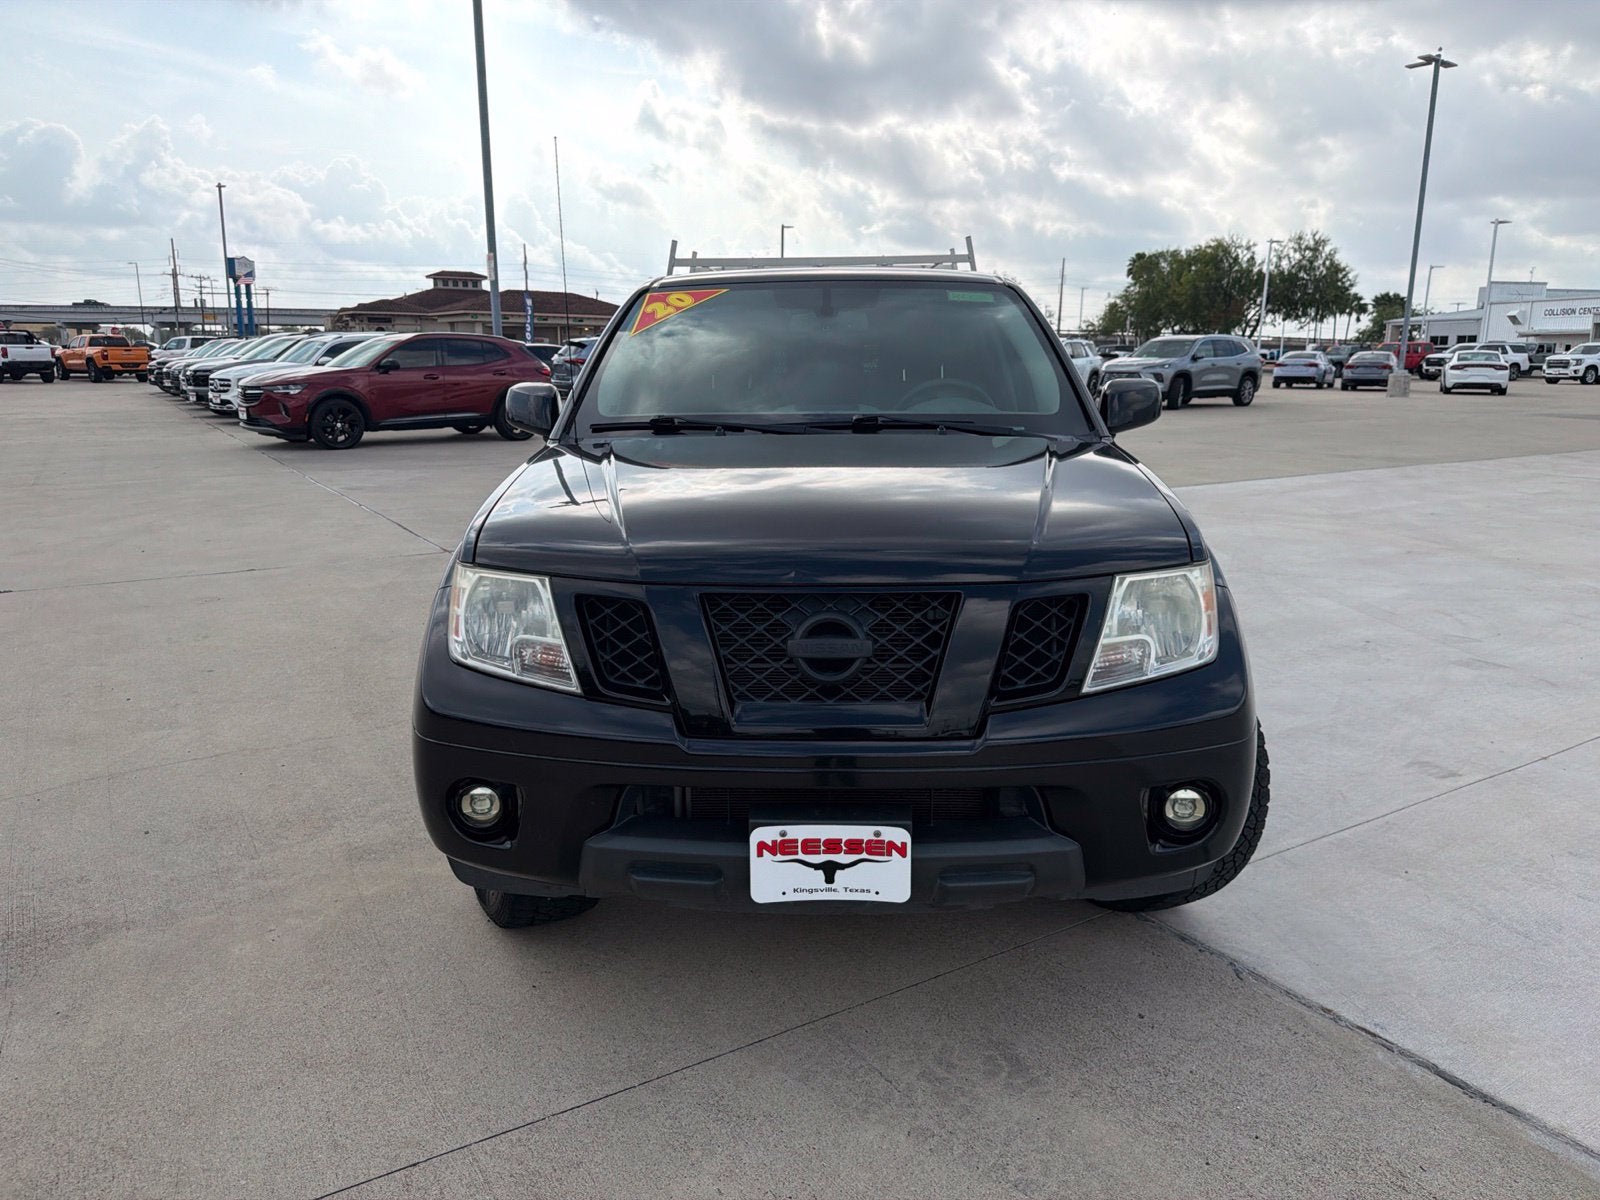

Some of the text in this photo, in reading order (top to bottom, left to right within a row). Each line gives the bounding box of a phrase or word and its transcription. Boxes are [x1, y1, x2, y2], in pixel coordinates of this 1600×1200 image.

[644, 293, 695, 319] 20
[1544, 308, 1576, 317] COLLISION
[796, 642, 865, 655] NISSAN
[756, 838, 908, 859] NEESSEN
[793, 886, 871, 895] Kingsville, Texas
